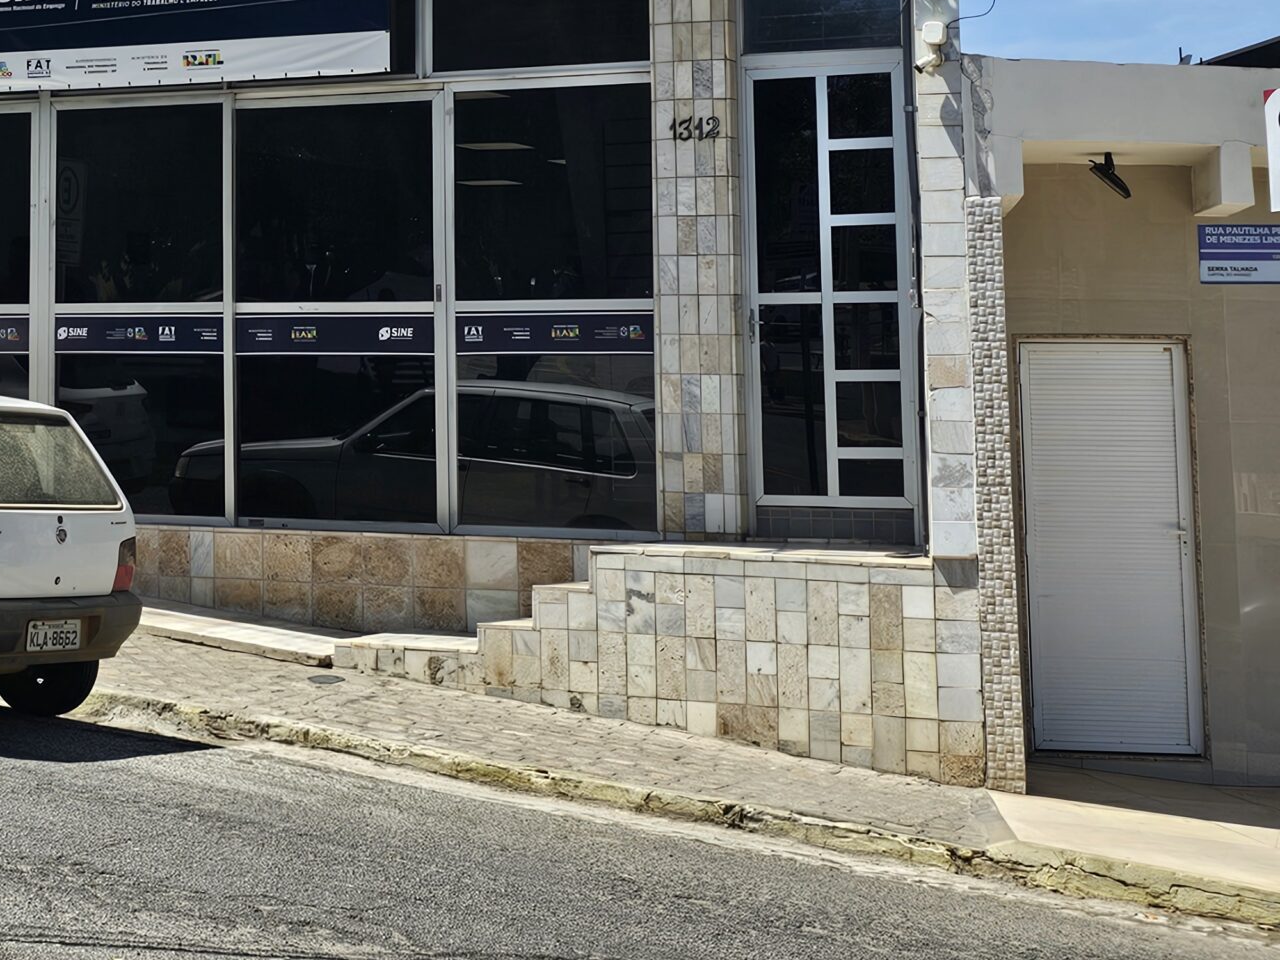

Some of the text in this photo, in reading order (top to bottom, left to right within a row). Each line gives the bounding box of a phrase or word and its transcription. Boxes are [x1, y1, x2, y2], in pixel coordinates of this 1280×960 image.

[669, 116, 720, 142] 1312
[1205, 226, 1225, 234] RUA
[1226, 226, 1270, 234] PAUTILHA
[1205, 235, 1218, 244] DE
[1220, 235, 1261, 244] MENEZES
[391, 327, 414, 337] SINE
